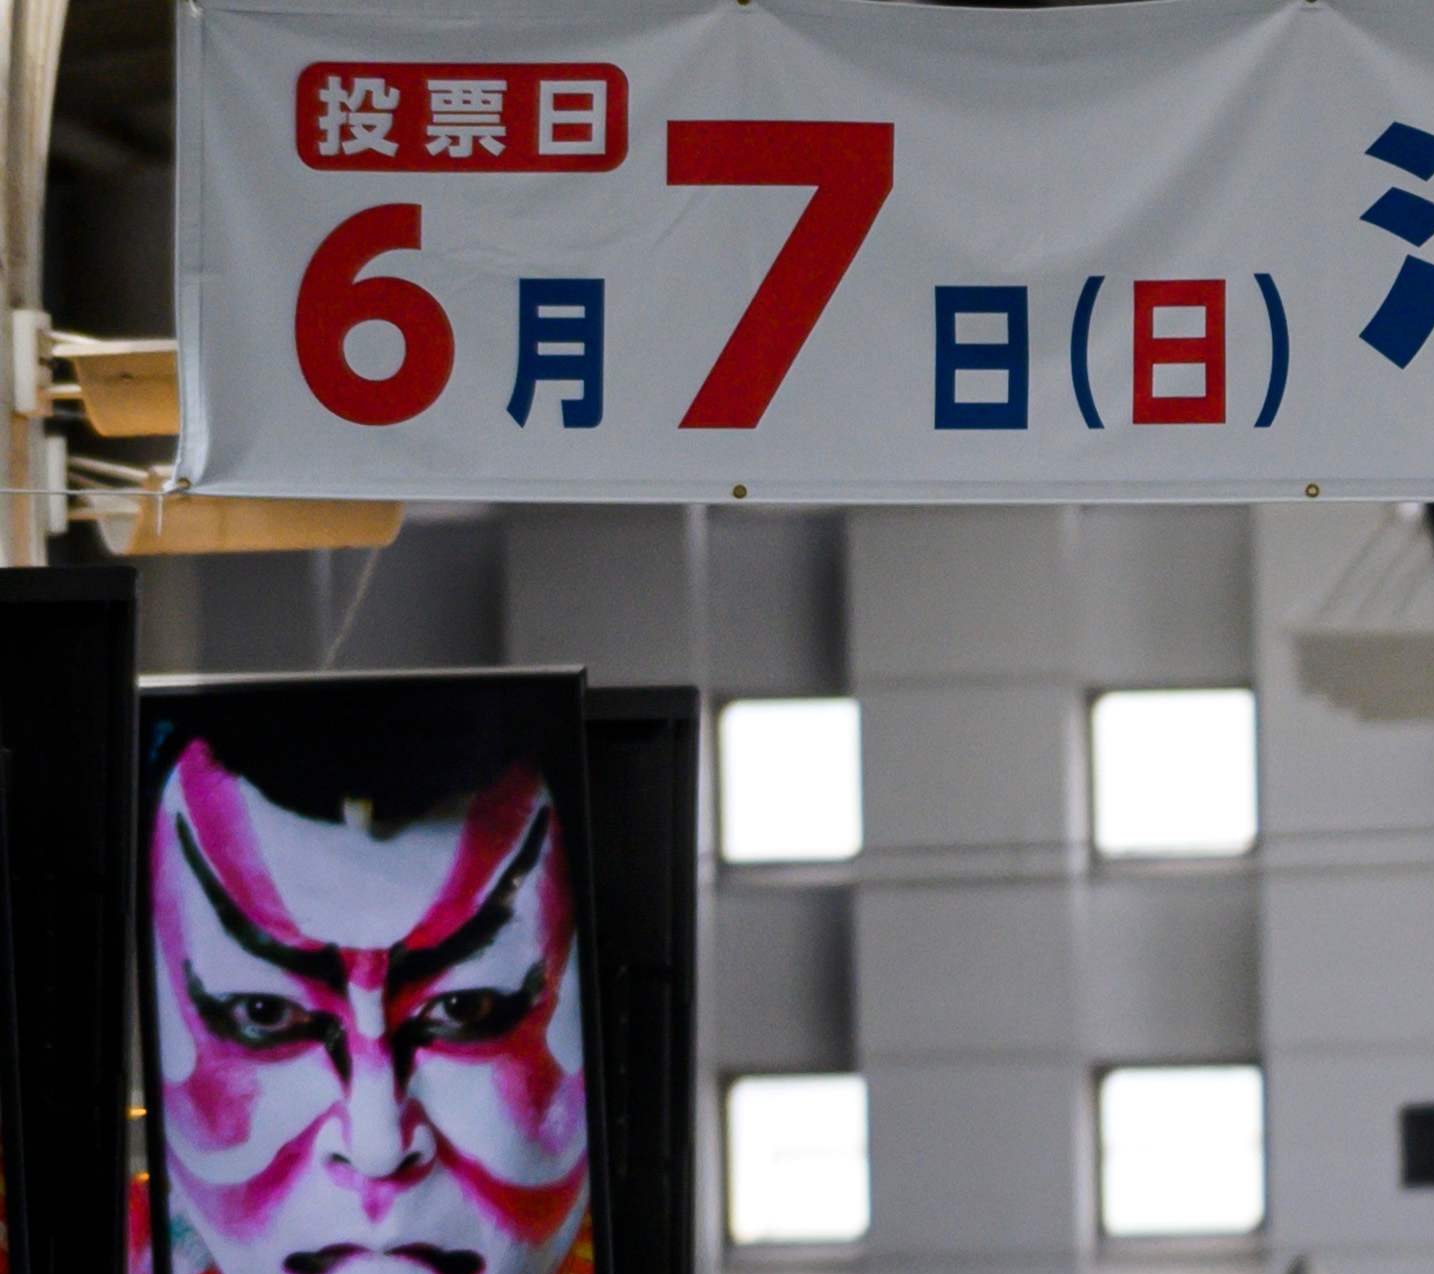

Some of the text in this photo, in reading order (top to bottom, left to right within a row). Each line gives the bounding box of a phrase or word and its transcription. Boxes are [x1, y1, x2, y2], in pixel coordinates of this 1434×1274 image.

[318, 75, 608, 158] 投票日
[294, 119, 1290, 430] 6月7日(日)
